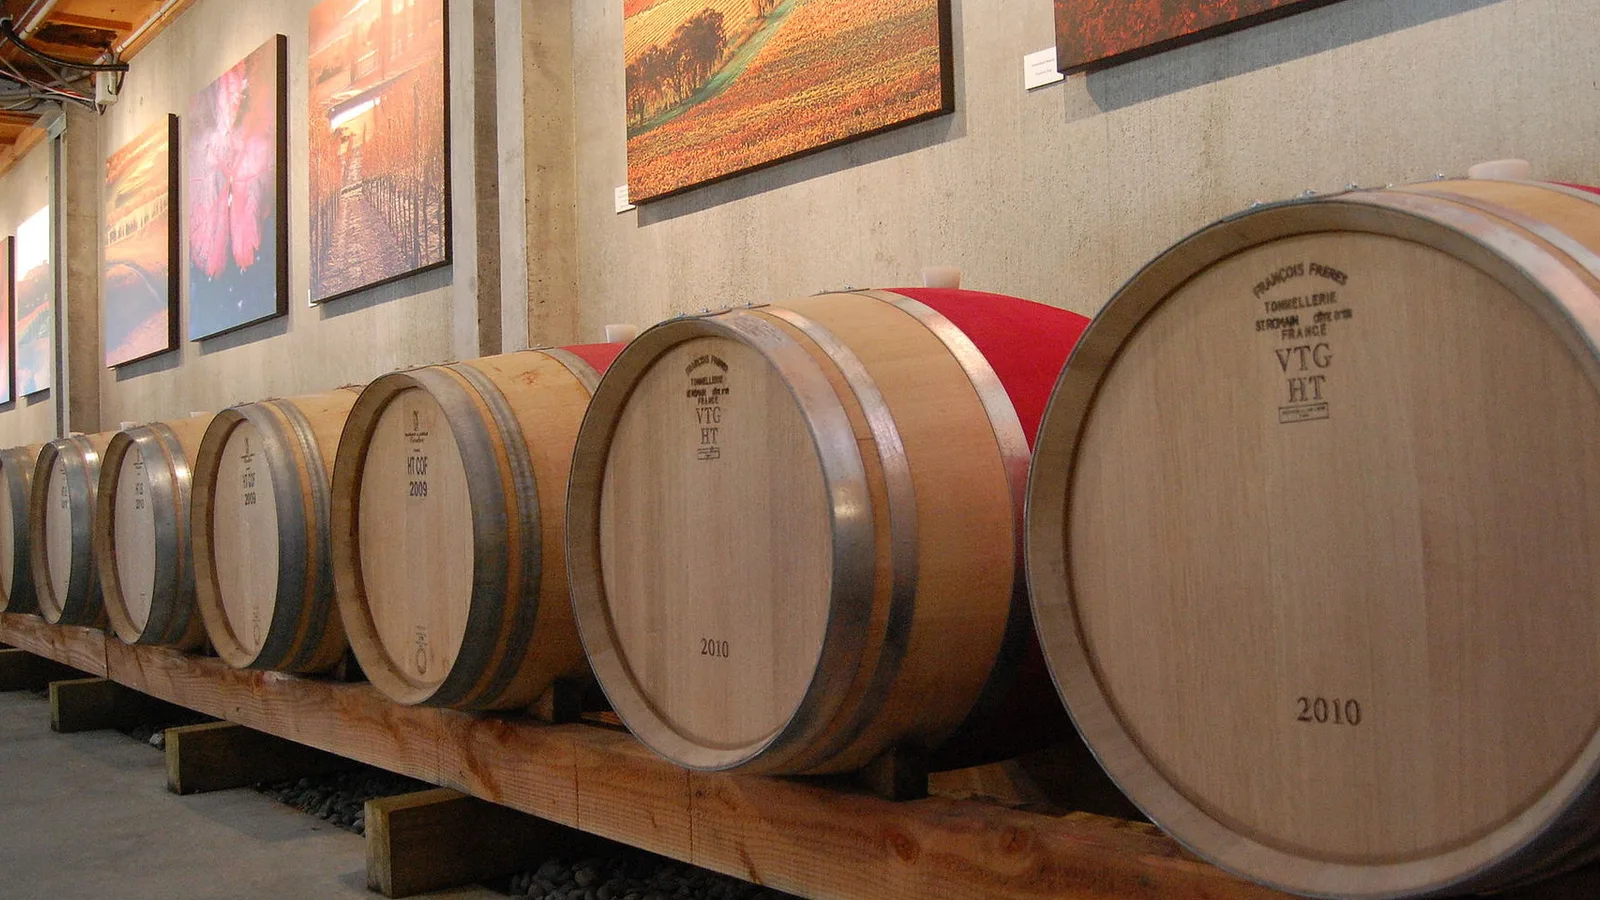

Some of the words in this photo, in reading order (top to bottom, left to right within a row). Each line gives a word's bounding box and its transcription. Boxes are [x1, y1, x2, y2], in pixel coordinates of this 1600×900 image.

[1281, 324, 1327, 340] FRANCE
[1275, 342, 1333, 372] VTG
[1287, 375, 1326, 403] HT
[696, 406, 721, 424] VTG
[701, 427, 719, 445] HT
[409, 481, 428, 497] 2009
[701, 637, 729, 658] 2010
[1297, 697, 1362, 726] 2010
